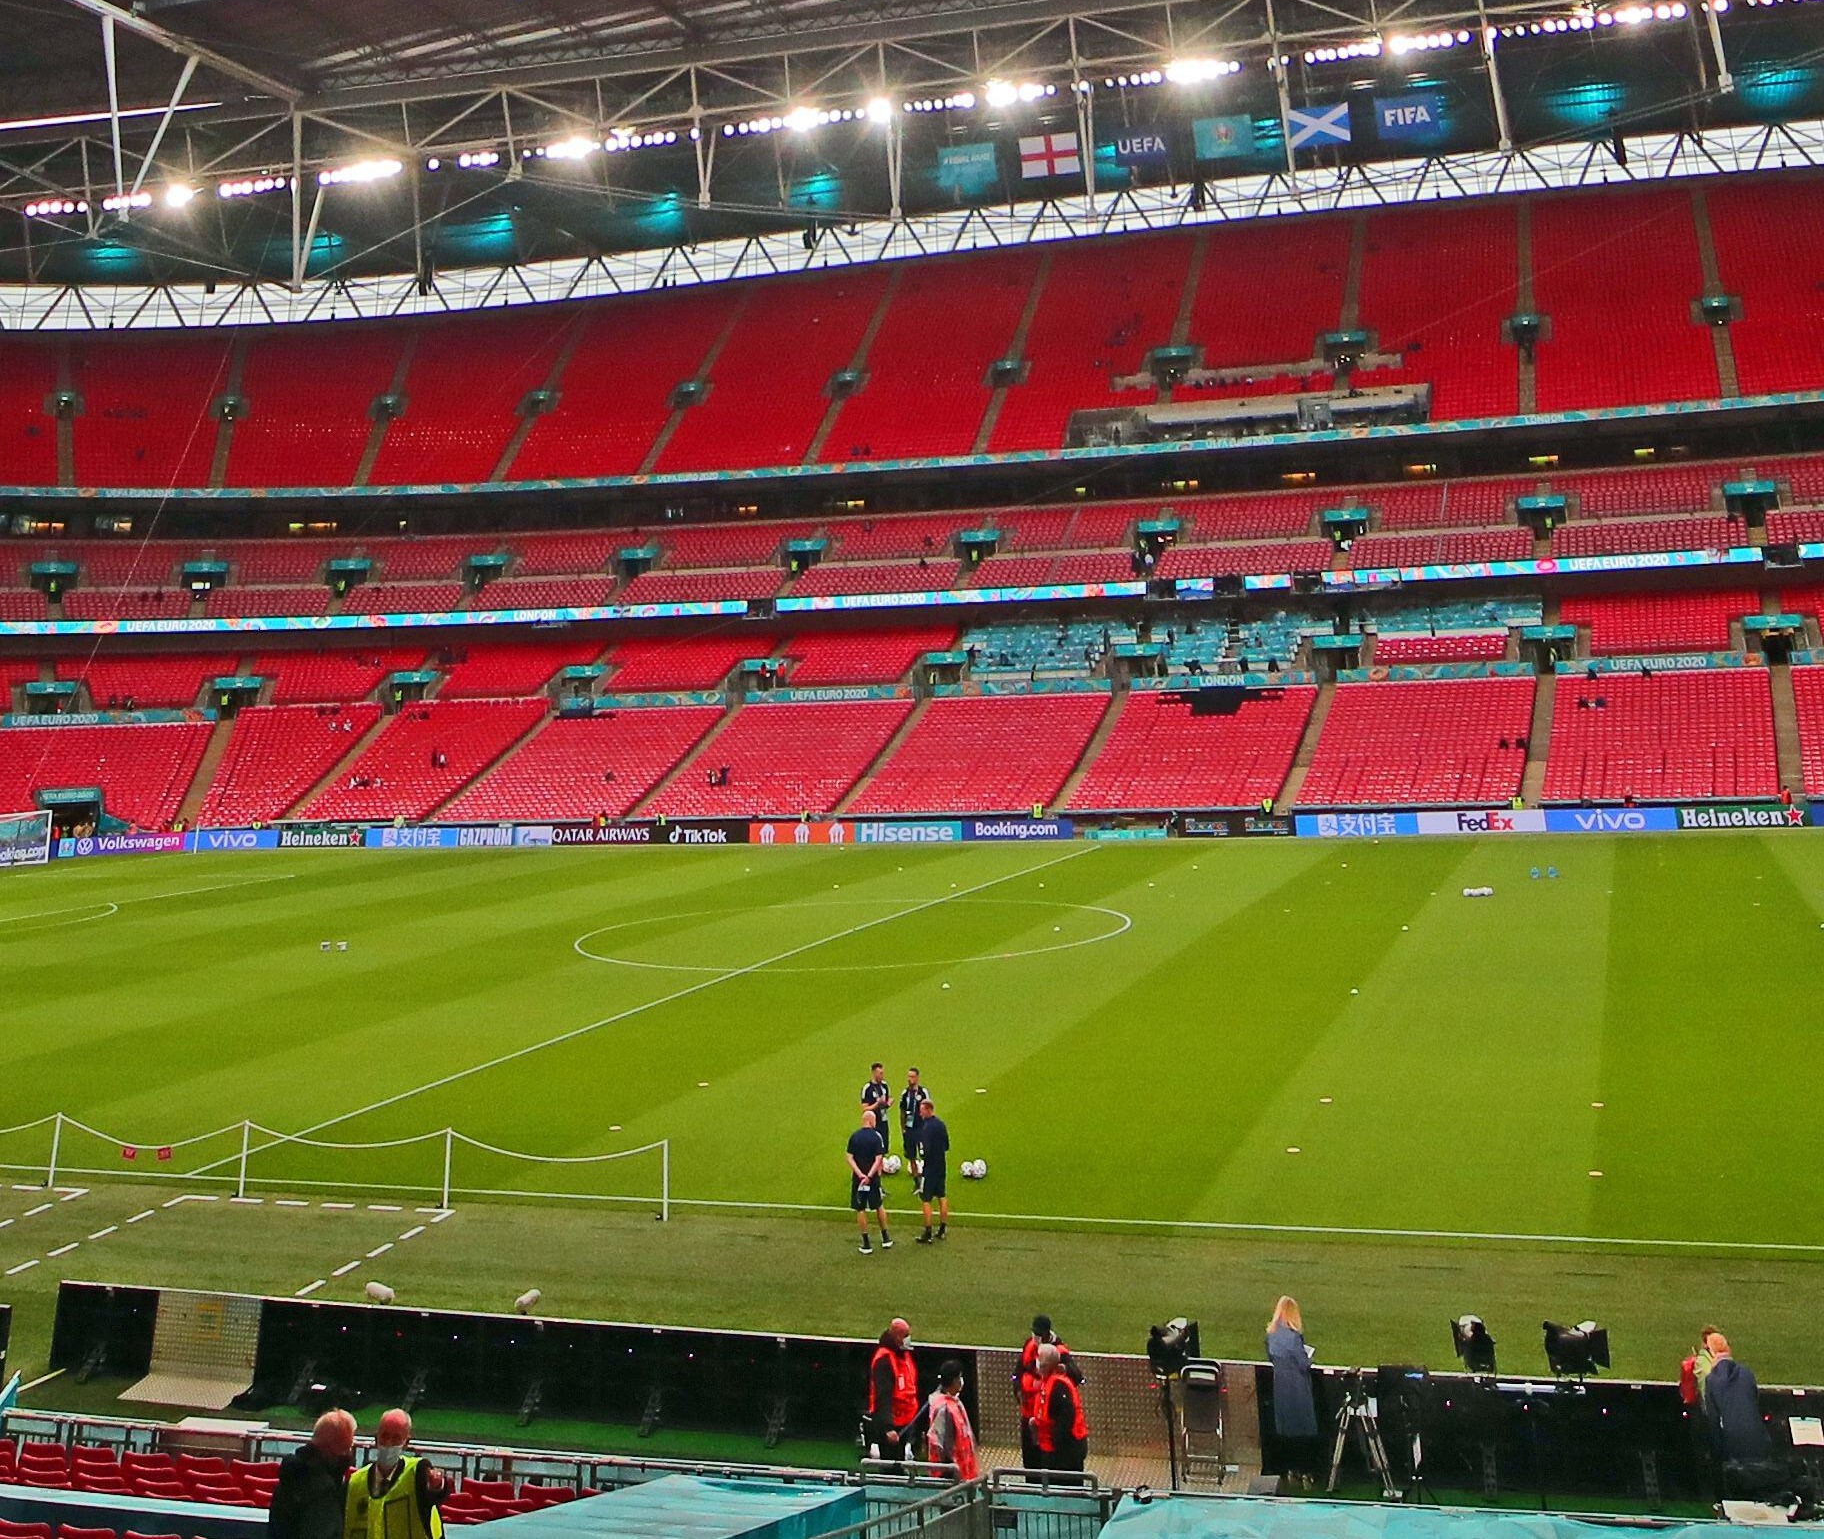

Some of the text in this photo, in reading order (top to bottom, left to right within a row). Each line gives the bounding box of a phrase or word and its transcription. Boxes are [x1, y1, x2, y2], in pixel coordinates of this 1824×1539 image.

[1384, 105, 1431, 127] FIFA
[1118, 136, 1166, 154] UEFA
[1569, 553, 1669, 570] UEFA EURO 2020
[842, 592, 926, 608] UEFA EURO 2020
[513, 609, 556, 622] LONDON
[126, 619, 216, 633] UEFA EURO 2020
[1610, 656, 1707, 671] UEFA EURO 2020
[1198, 674, 1245, 687] LONDON
[790, 688, 869, 701] UEFA EURO 2020
[11, 713, 99, 727] UEFA EURO 2020
[1341, 811, 1398, 836] 支付宝
[1457, 811, 1514, 832] FedEx
[1576, 808, 1646, 831] vivo
[1682, 807, 1783, 828] Heineken
[209, 829, 257, 849] vivo
[280, 829, 350, 847] Heineken
[460, 827, 512, 846] GAZPROM
[552, 828, 593, 844] QATAR
[596, 826, 650, 843] AIRWAYS
[684, 828, 727, 844] TikTok
[861, 821, 954, 843] Hisense
[975, 821, 1059, 839] Booking.com
[98, 835, 179, 855] Volkswagen
